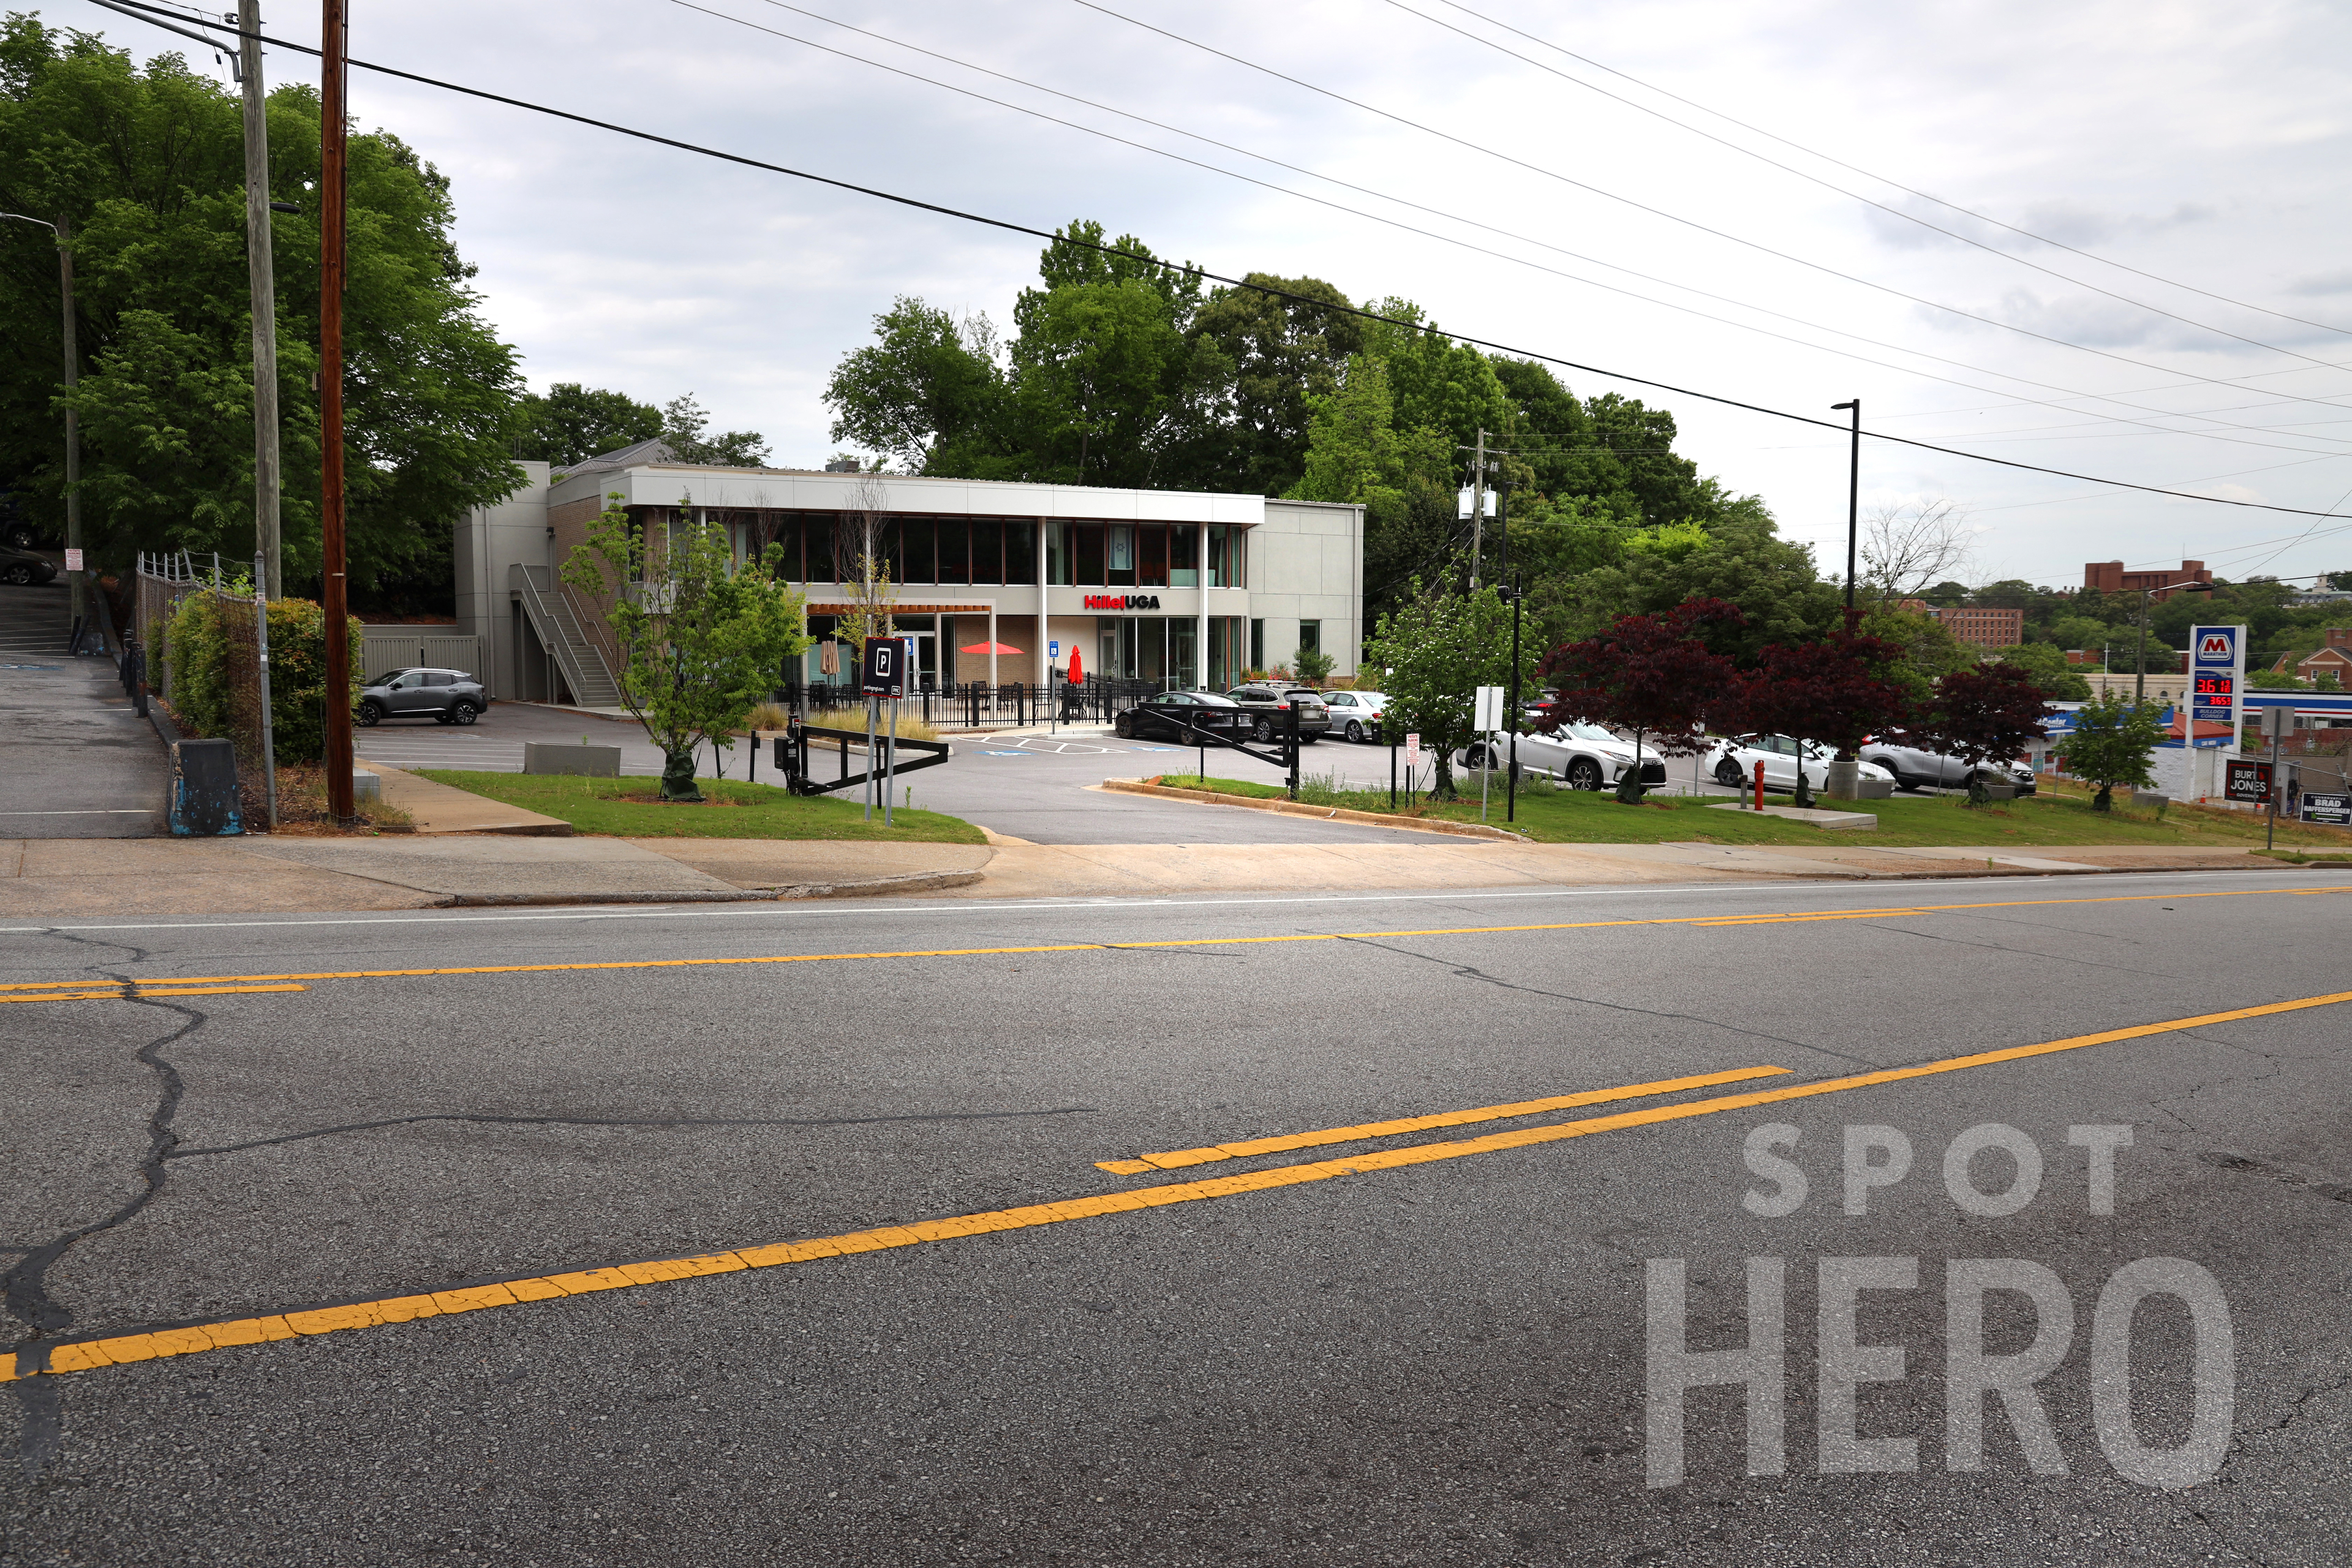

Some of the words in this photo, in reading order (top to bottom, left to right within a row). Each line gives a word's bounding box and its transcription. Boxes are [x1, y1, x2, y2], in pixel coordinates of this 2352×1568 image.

[880, 655, 887, 669] P
[2231, 780, 2266, 792] JONES
[2315, 799, 2342, 807] BRAD
[2304, 805, 2351, 814] RAFFENSPERGER
